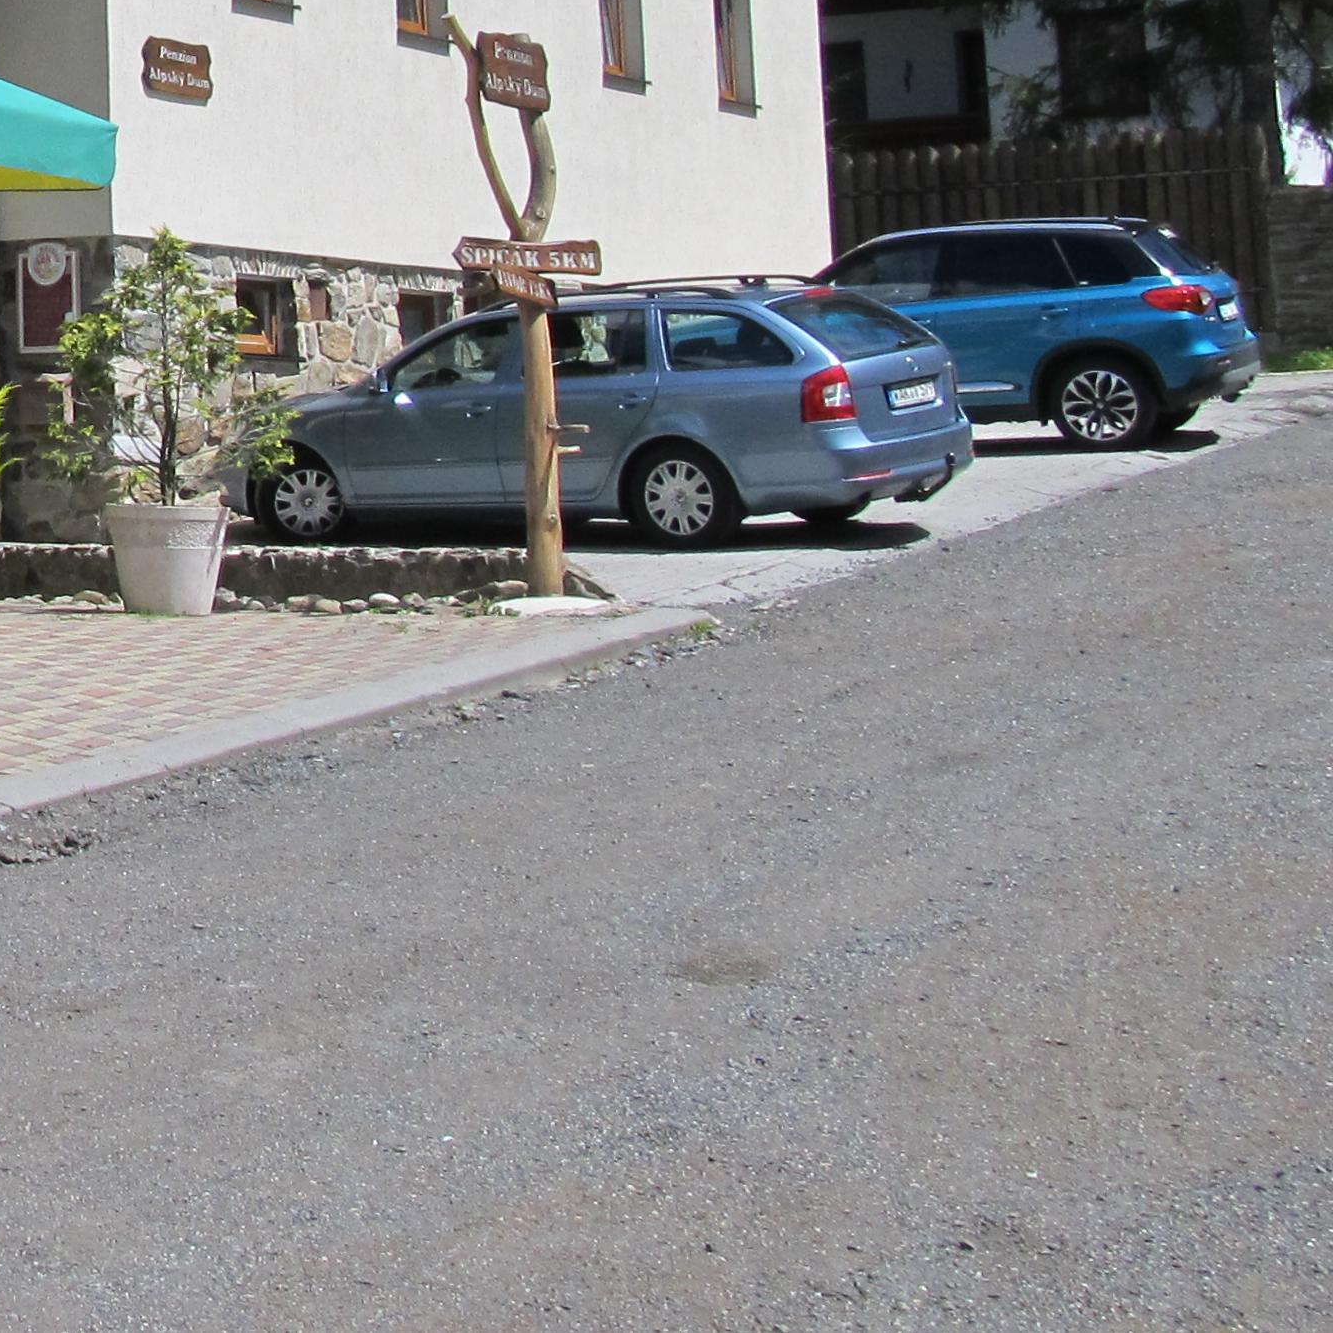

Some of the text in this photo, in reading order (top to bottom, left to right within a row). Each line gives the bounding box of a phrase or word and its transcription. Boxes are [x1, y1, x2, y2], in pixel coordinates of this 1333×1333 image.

[159, 46, 197, 64] Penzion
[460, 242, 596, 269] ŠPIČÁK 5KM
